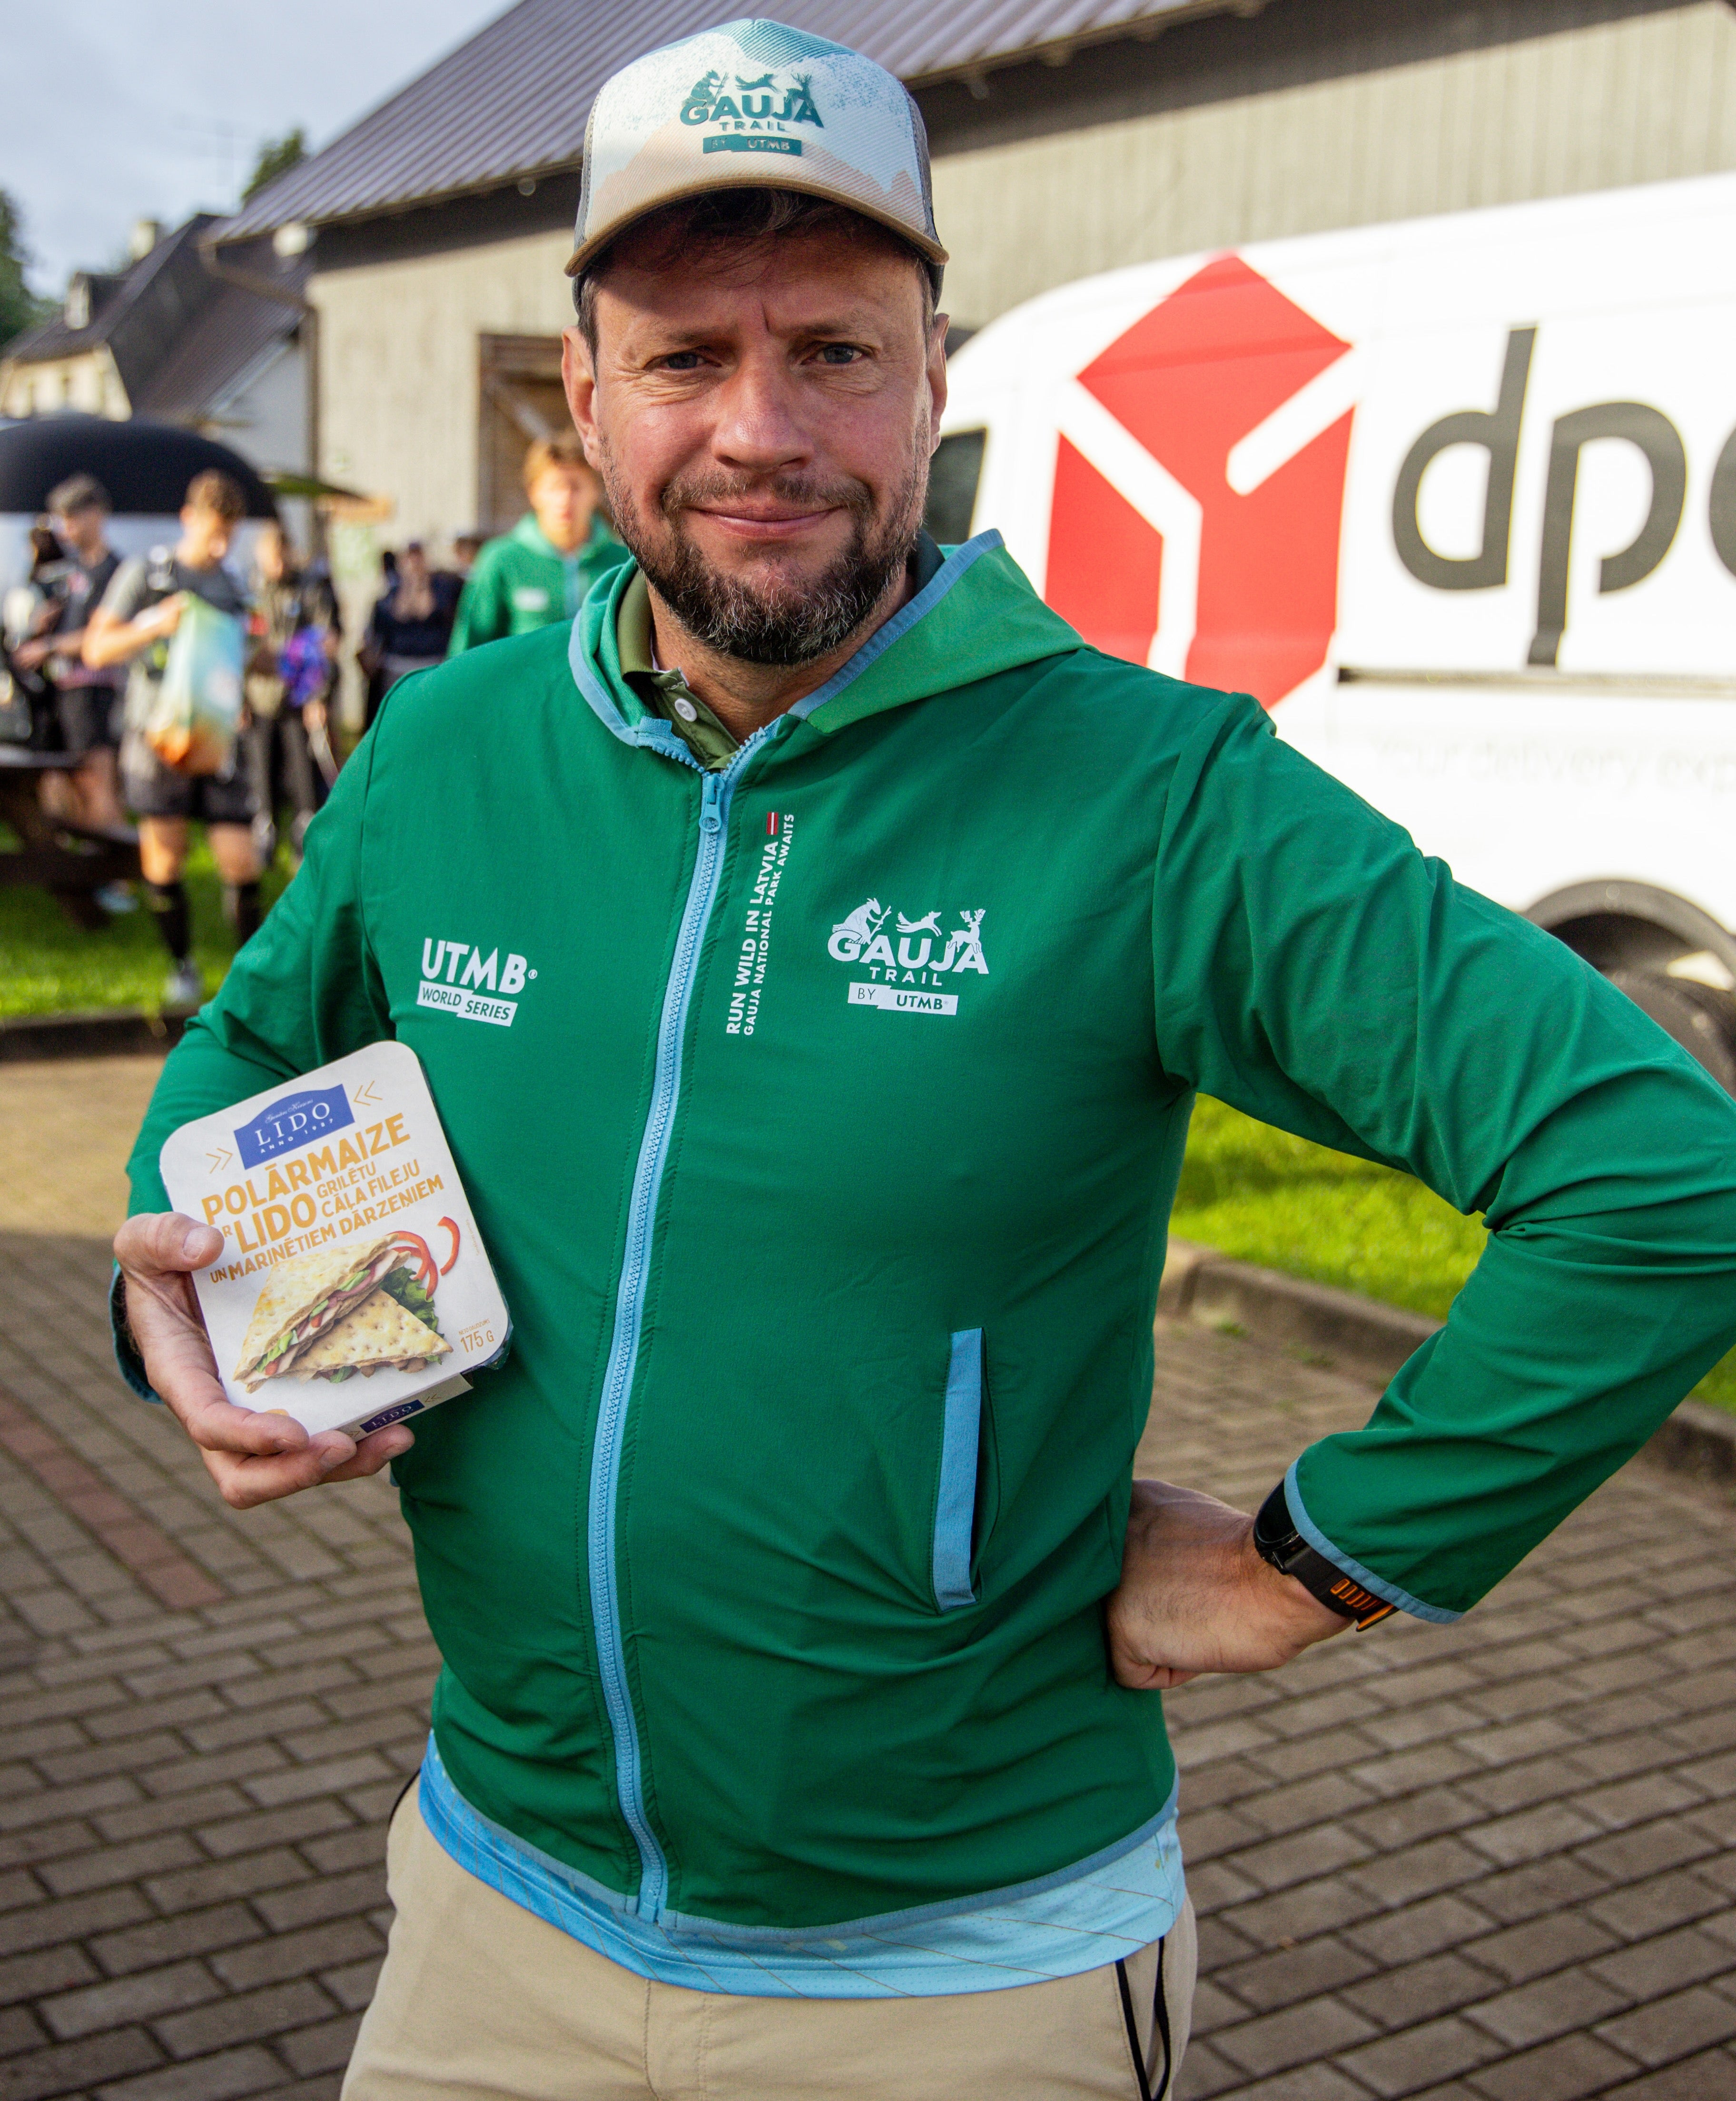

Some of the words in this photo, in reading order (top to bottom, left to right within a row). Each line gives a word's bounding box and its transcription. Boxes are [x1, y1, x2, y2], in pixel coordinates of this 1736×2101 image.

[680, 95, 824, 128] GAUJA
[720, 120, 789, 131] TRAIL
[711, 138, 728, 149] BY
[747, 139, 790, 150] UTMB
[750, 842, 779, 903] LATVIA
[744, 989, 761, 1035] GAUJA
[753, 911, 772, 983] NATIONAL
[765, 871, 782, 905] PARK
[777, 814, 794, 866] AWAITS
[746, 910, 760, 932] IN
[734, 939, 756, 986] WILD
[827, 929, 989, 974] GAUJA
[858, 988, 876, 1000] BY
[869, 966, 943, 986] TRAIL
[423, 987, 462, 1006] WORLD
[465, 1000, 511, 1020] SERIES
[726, 992, 746, 1034] RUN
[255, 1102, 330, 1146] LIDO
[261, 1136, 294, 1153] ANNO
[201, 1112, 411, 1226] POLĀRMAIZE
[317, 1161, 376, 1199] GRILĒTU
[322, 1187, 367, 1217] CĀĻA
[367, 1159, 420, 1198] FILEJU
[210, 1267, 227, 1283] UN
[227, 1223, 337, 1281] MARINĒTIEM
[338, 1174, 444, 1235] DĀRZEŅIEM
[234, 1193, 317, 1254] LIDO
[460, 1330, 484, 1353] 175
[486, 1330, 494, 1342] G
[371, 1406, 412, 1426] LIDO
